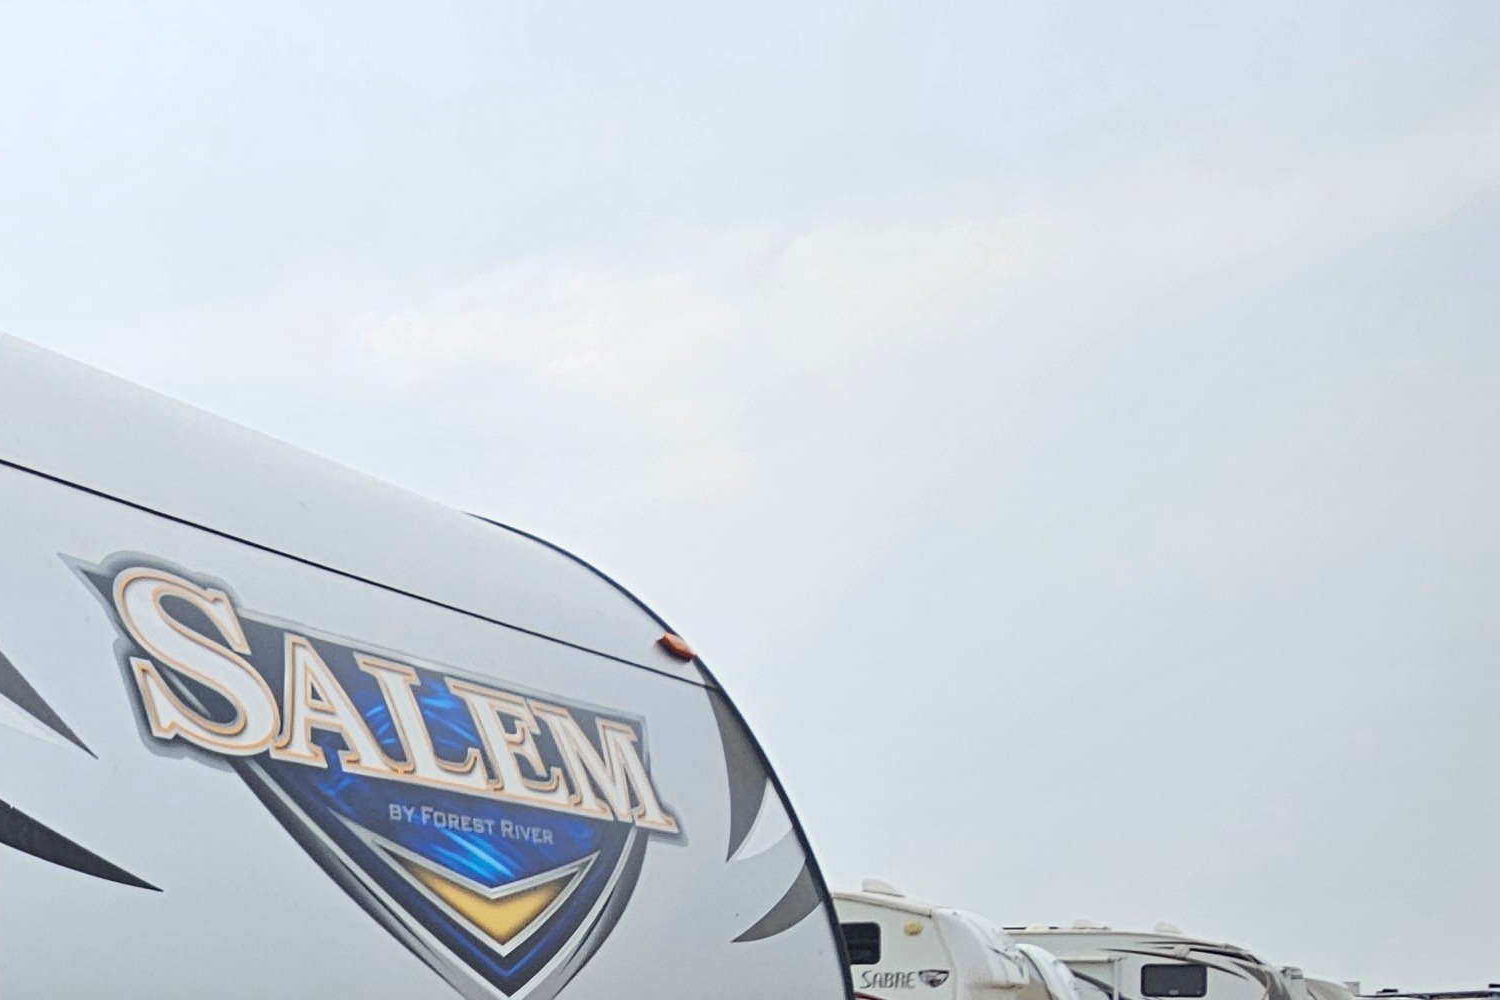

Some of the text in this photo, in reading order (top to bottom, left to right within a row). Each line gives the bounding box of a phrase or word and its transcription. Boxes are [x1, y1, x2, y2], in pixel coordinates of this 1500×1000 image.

[113, 566, 679, 833] SALEM
[388, 803, 554, 846] BY FOREST RIVER
[860, 970, 916, 989] SABRE
